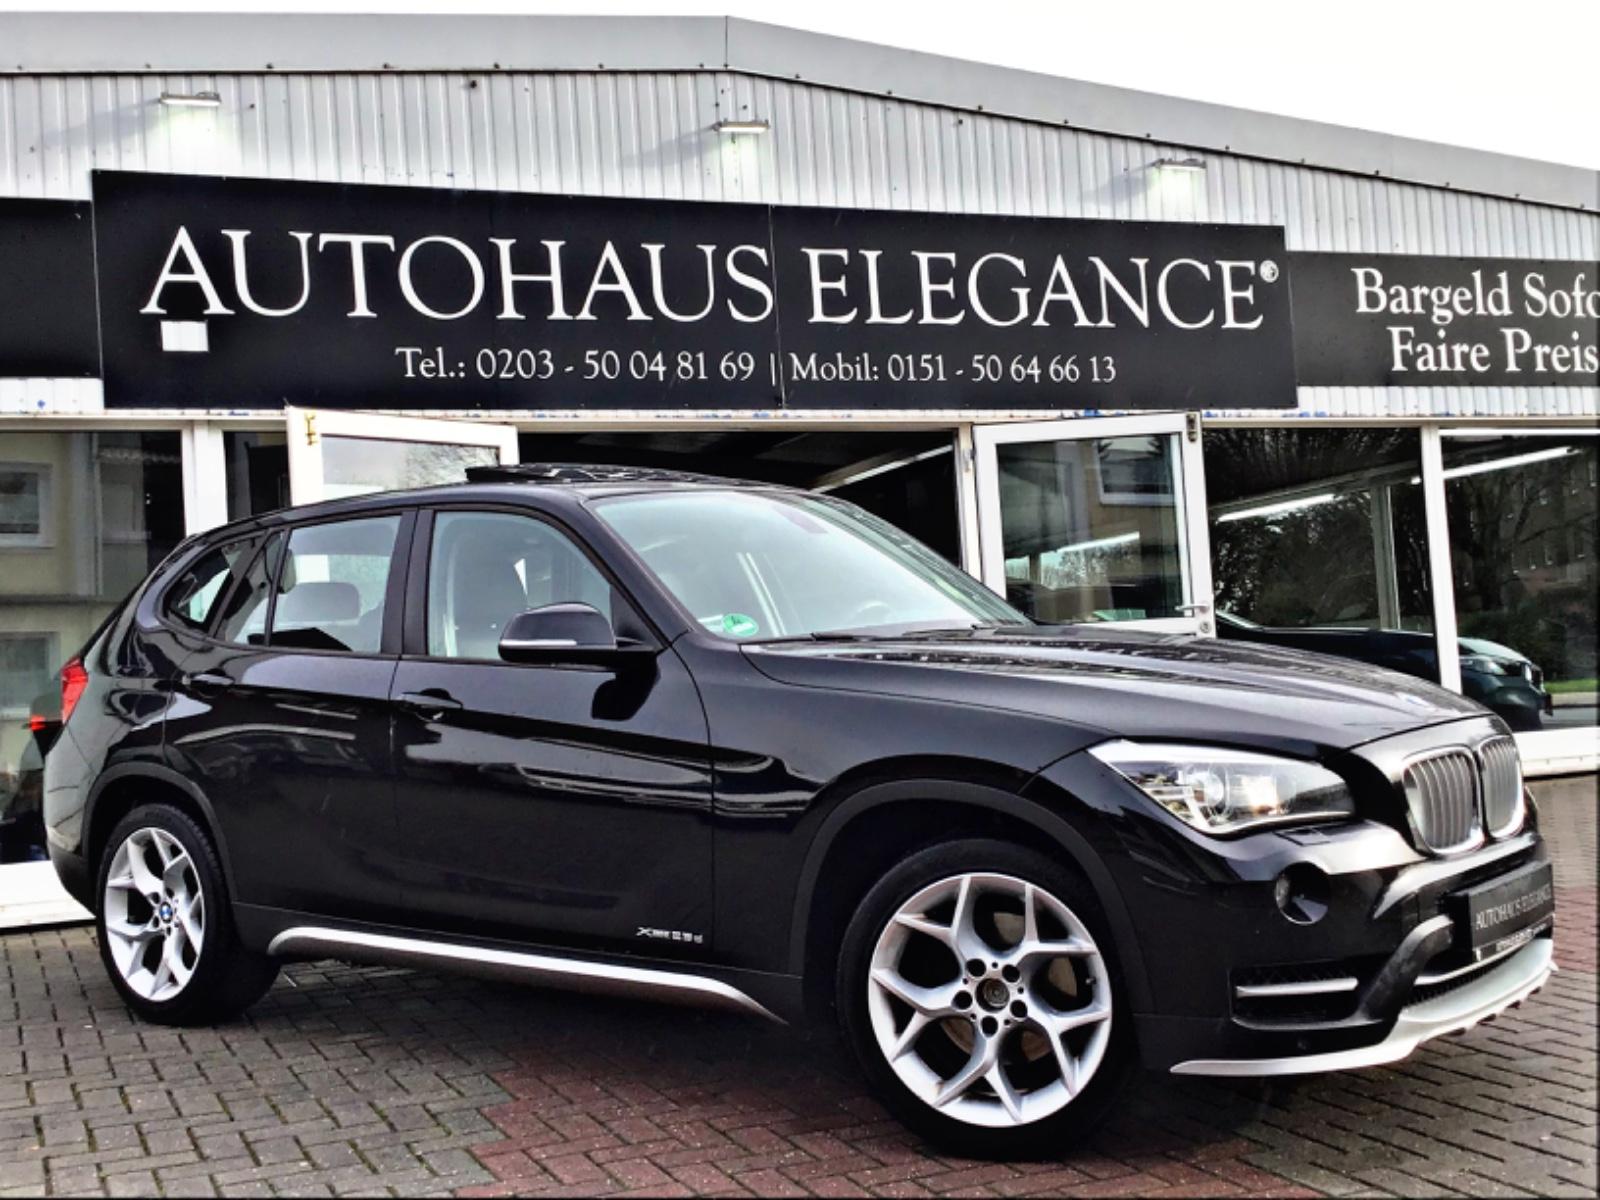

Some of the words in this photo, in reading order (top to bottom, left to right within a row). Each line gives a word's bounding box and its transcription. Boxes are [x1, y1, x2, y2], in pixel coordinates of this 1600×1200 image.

[139, 225, 774, 323] AUTOHAUS
[1350, 267, 1514, 326] Bargeld
[395, 347, 466, 379] Tel.:
[476, 348, 554, 380] 0203
[583, 349, 621, 380] 50
[629, 350, 667, 382] 04
[676, 350, 709, 381] 81
[719, 351, 755, 381] 69
[789, 352, 879, 382] Mobil:
[887, 353, 947, 382] 0151
[971, 354, 1003, 382] 50
[1009, 354, 1042, 384] 64
[1048, 354, 1080, 383] 66
[1089, 355, 1117, 383] 13
[1386, 326, 1491, 373] Faire
[1499, 327, 1599, 374] Preis
[1475, 898, 1521, 931] AUTOHAUS
